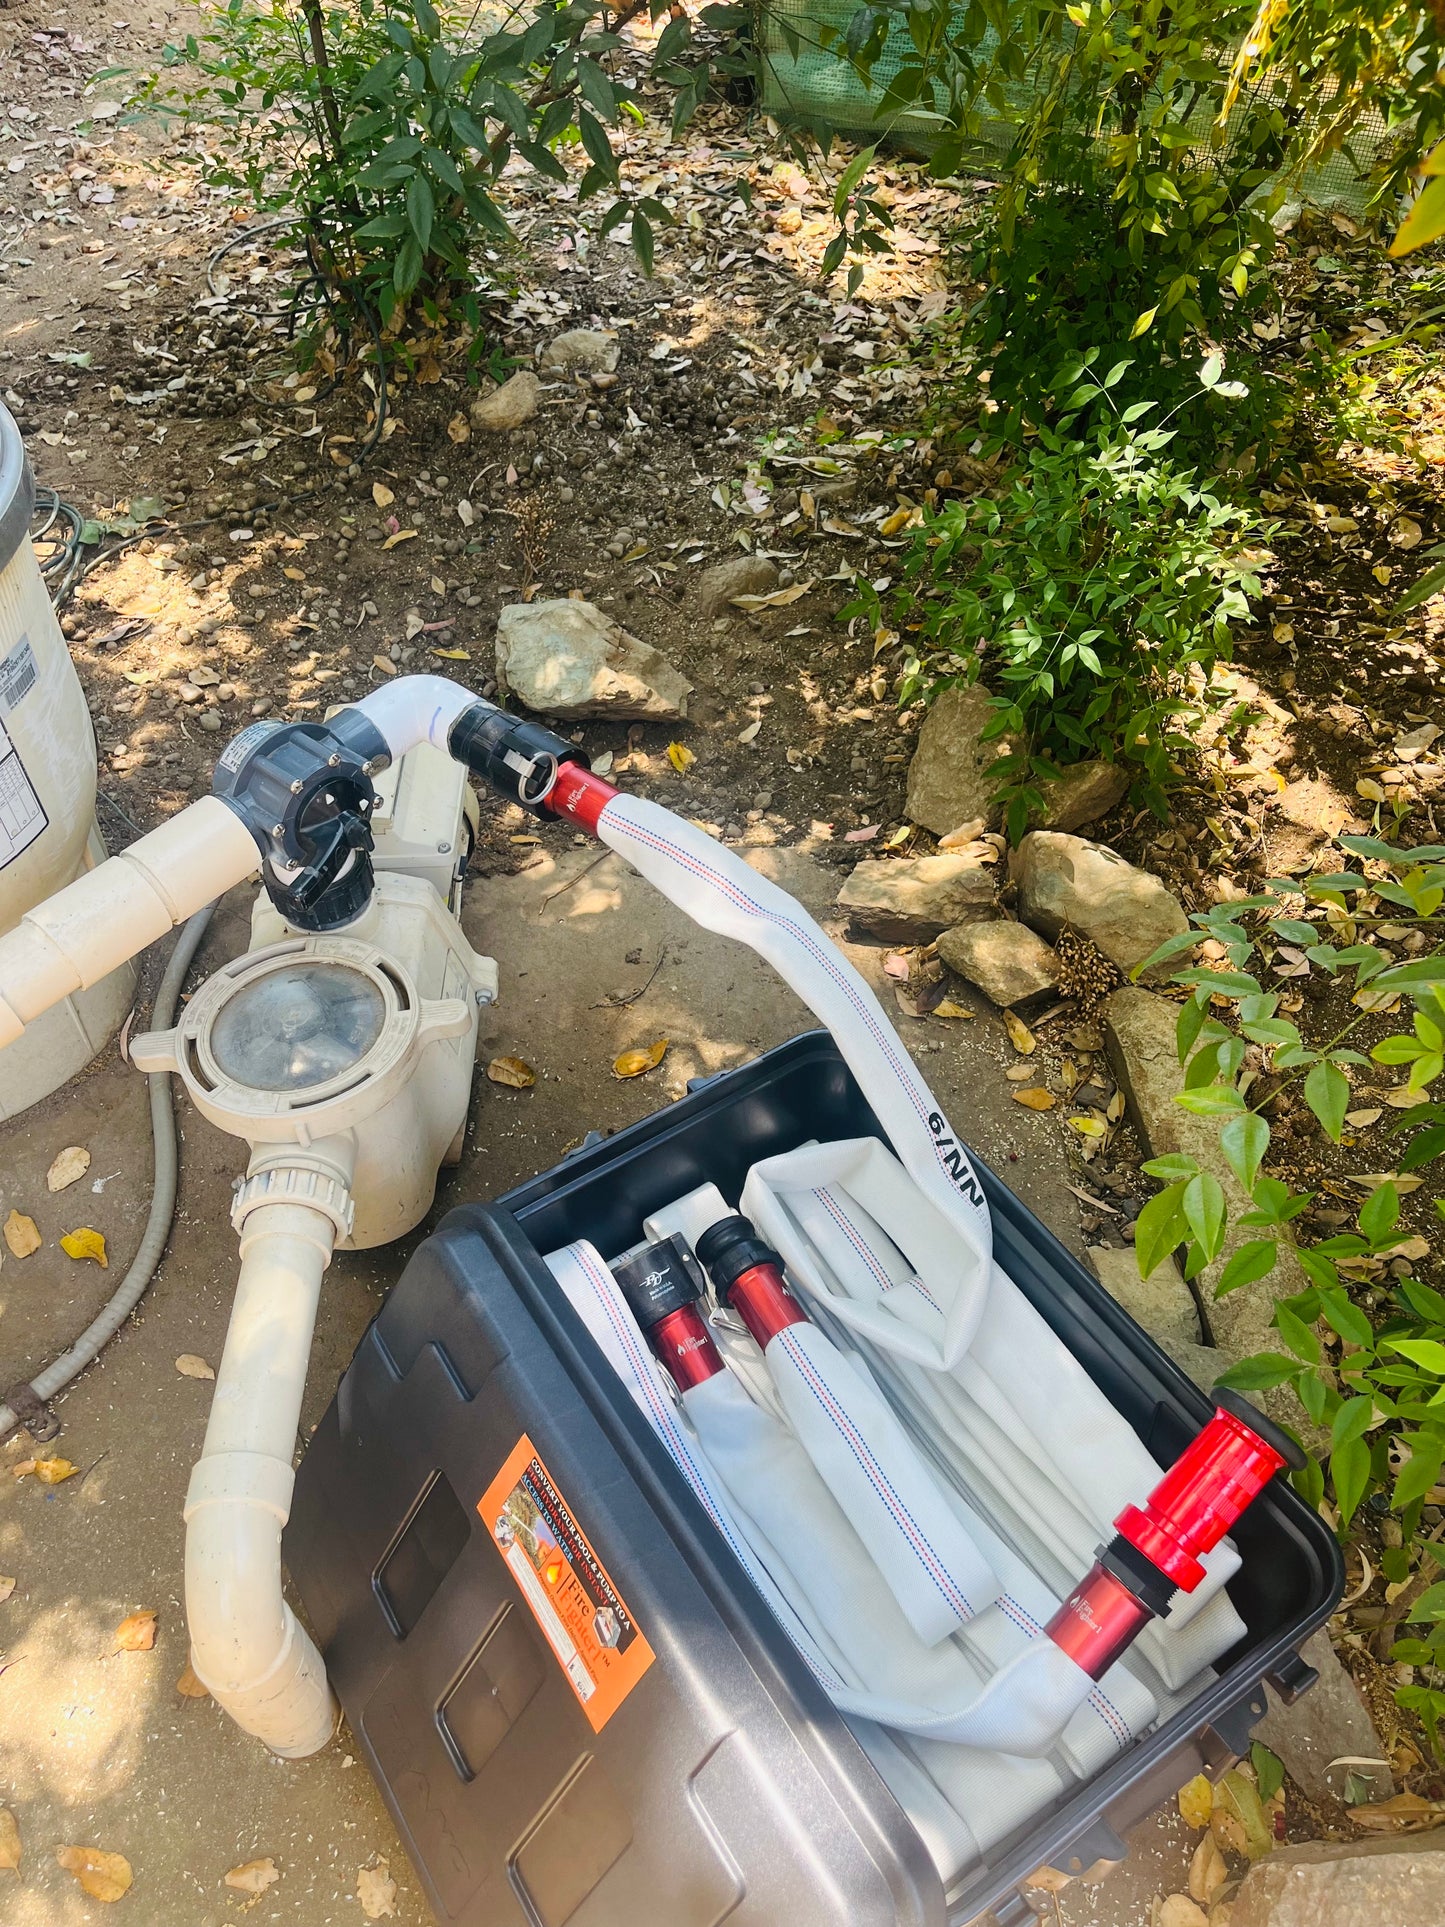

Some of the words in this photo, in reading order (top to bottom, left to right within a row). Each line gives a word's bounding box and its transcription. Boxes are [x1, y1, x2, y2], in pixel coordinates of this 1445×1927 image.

[522, 1474, 545, 1511] ACCESS
[542, 1508, 553, 1526] TO
[551, 1524, 574, 1563] WATER
[527, 1466, 541, 1491] FIRE
[539, 1489, 569, 1538] HYDRANT
[567, 1538, 582, 1561] FOR
[580, 1560, 608, 1606] INSTANT
[531, 1458, 560, 1506] CONVERT
[557, 1504, 577, 1535] YOUR
[574, 1533, 593, 1563] POOL
[591, 1562, 598, 1573] &
[596, 1571, 616, 1604] PUMP
[614, 1601, 625, 1620] TO
[624, 1619, 631, 1631] A
[568, 1579, 591, 1617] Fire
[1079, 1599, 1095, 1615] Fire
